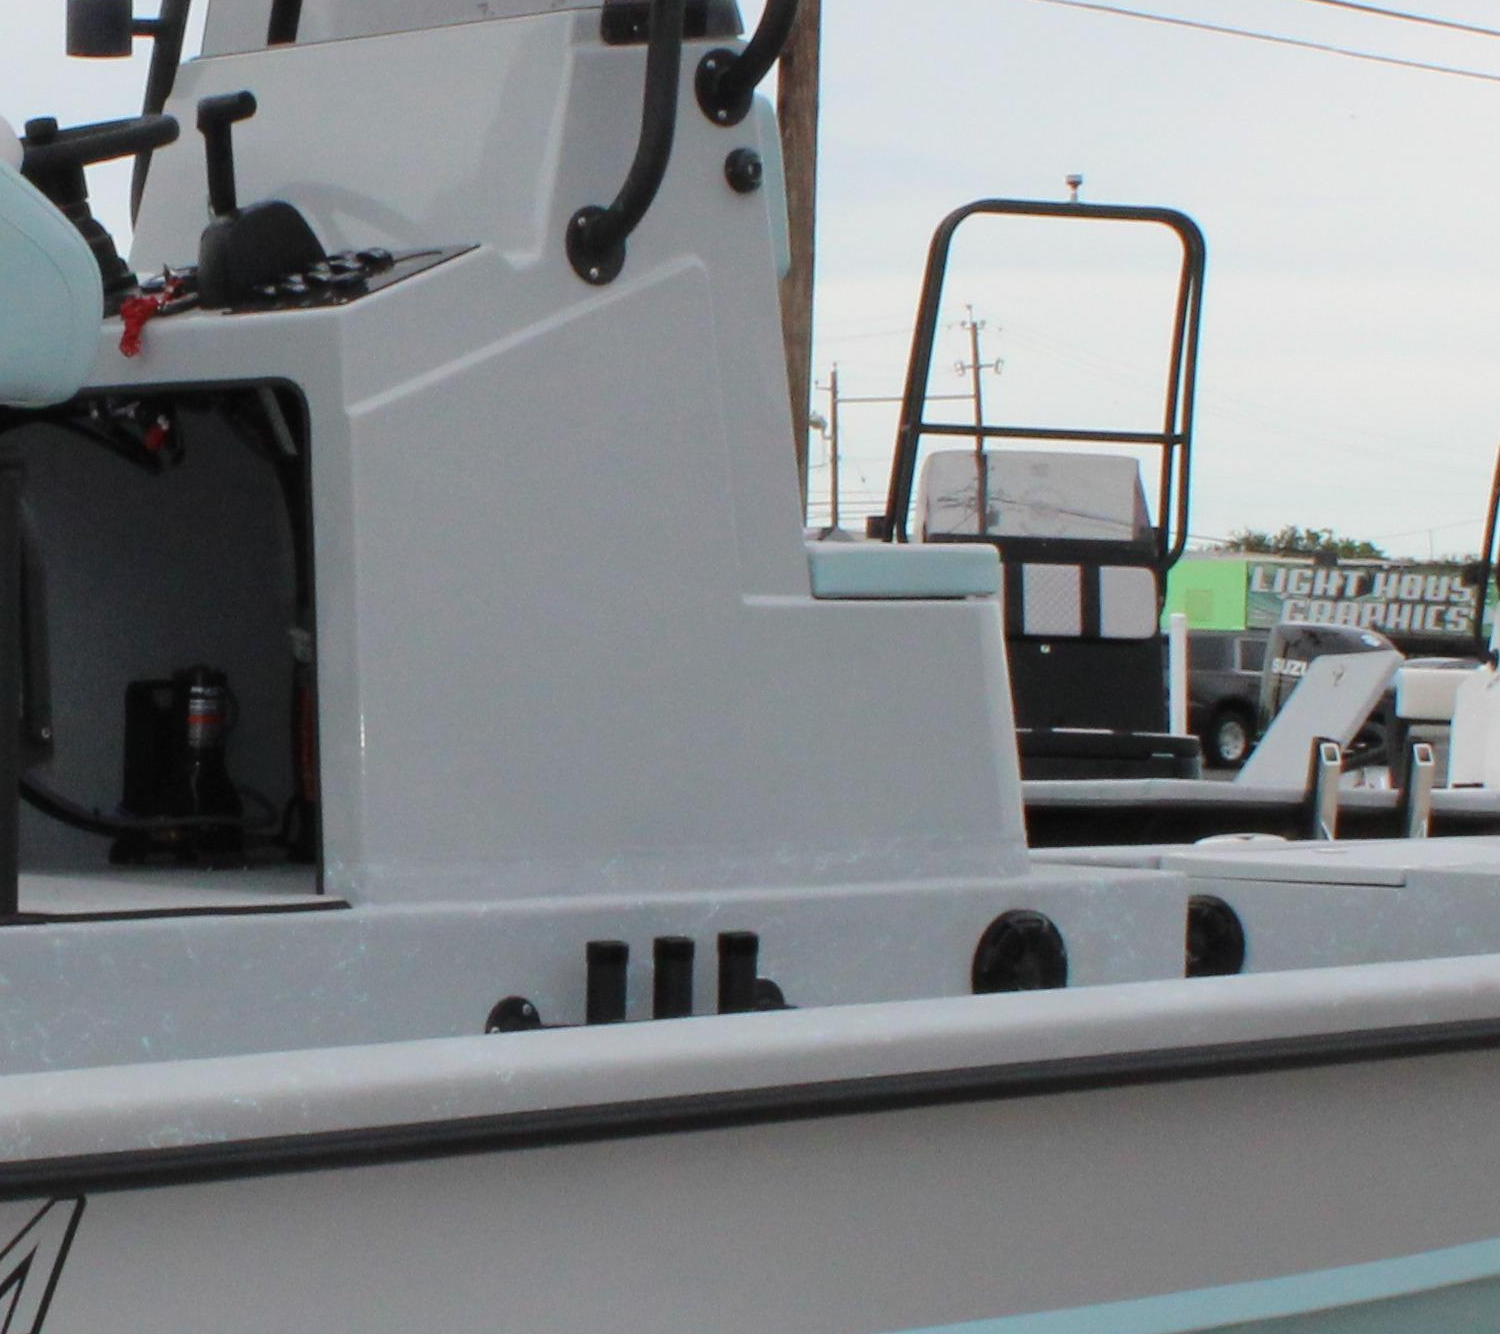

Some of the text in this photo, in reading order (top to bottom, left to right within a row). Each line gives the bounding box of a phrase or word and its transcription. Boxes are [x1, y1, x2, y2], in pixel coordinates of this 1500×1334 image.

[1251, 566, 1477, 605] LIGHT HOUS
[1283, 597, 1475, 633] GRAPHICS
